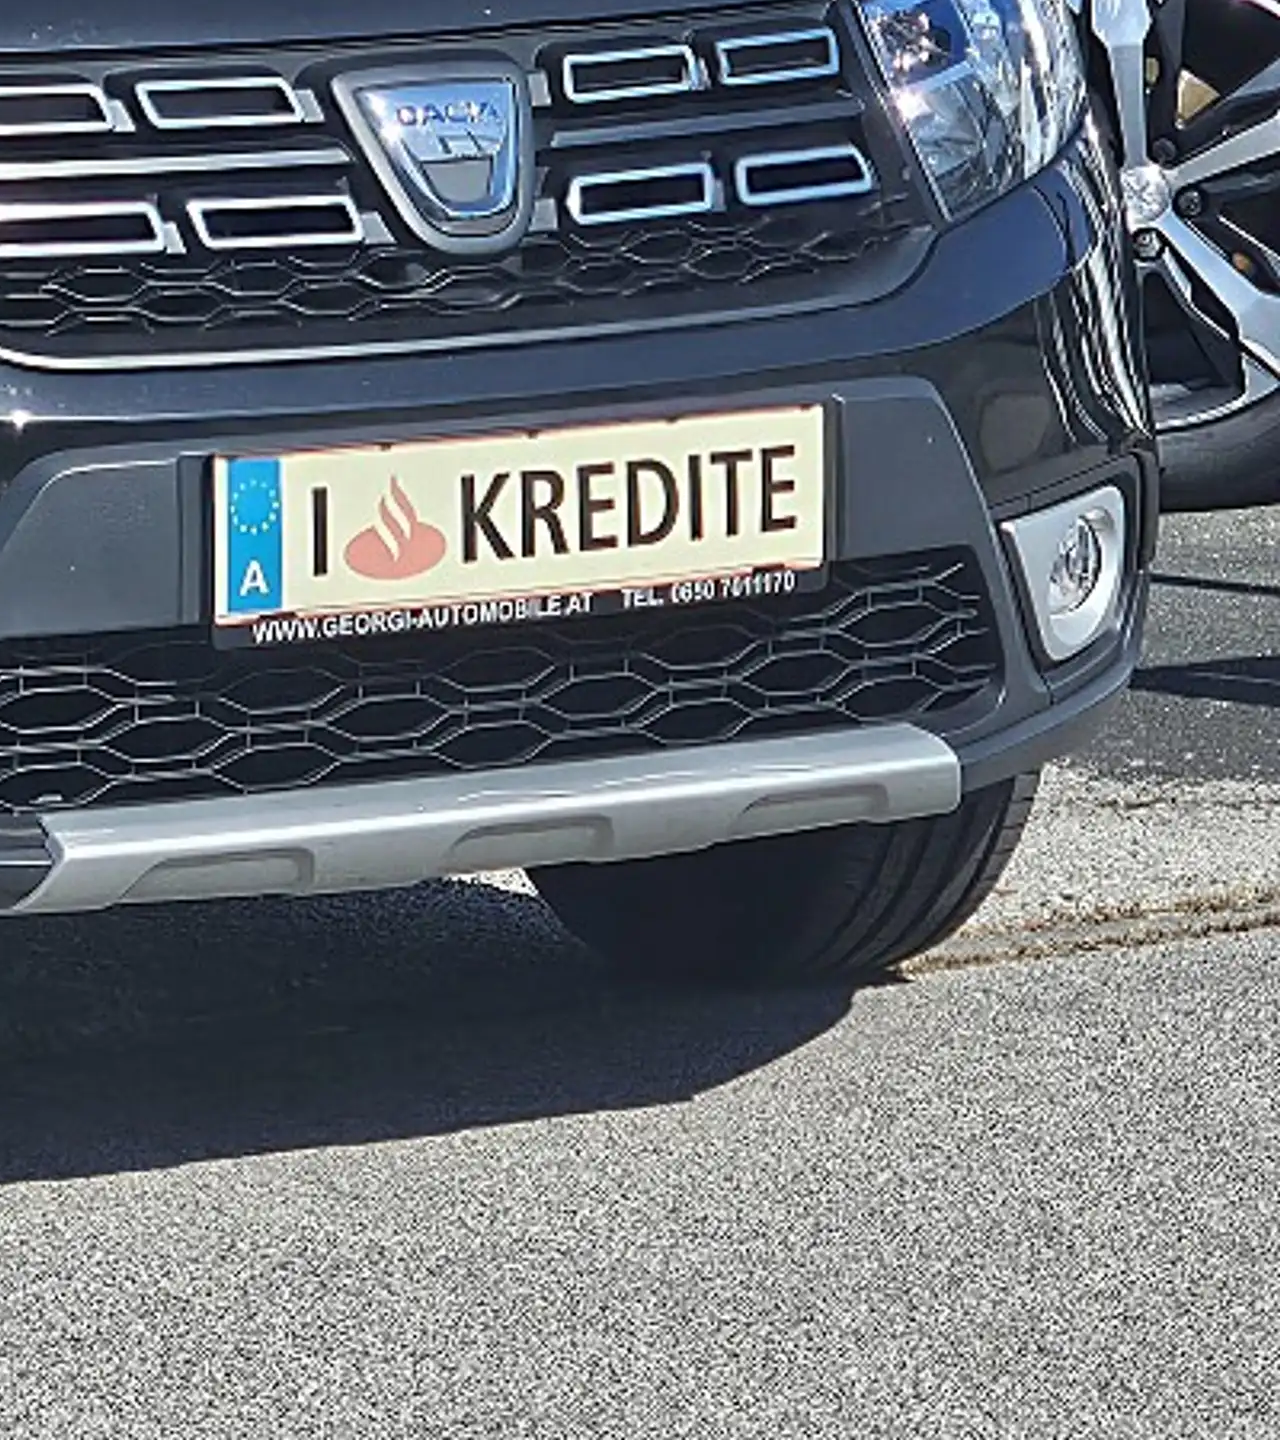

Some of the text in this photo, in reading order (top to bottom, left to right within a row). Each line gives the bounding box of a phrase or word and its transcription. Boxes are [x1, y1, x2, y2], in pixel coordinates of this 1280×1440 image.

[396, 101, 501, 126] DACIA
[460, 445, 798, 564] KREDITE
[240, 560, 270, 597] A
